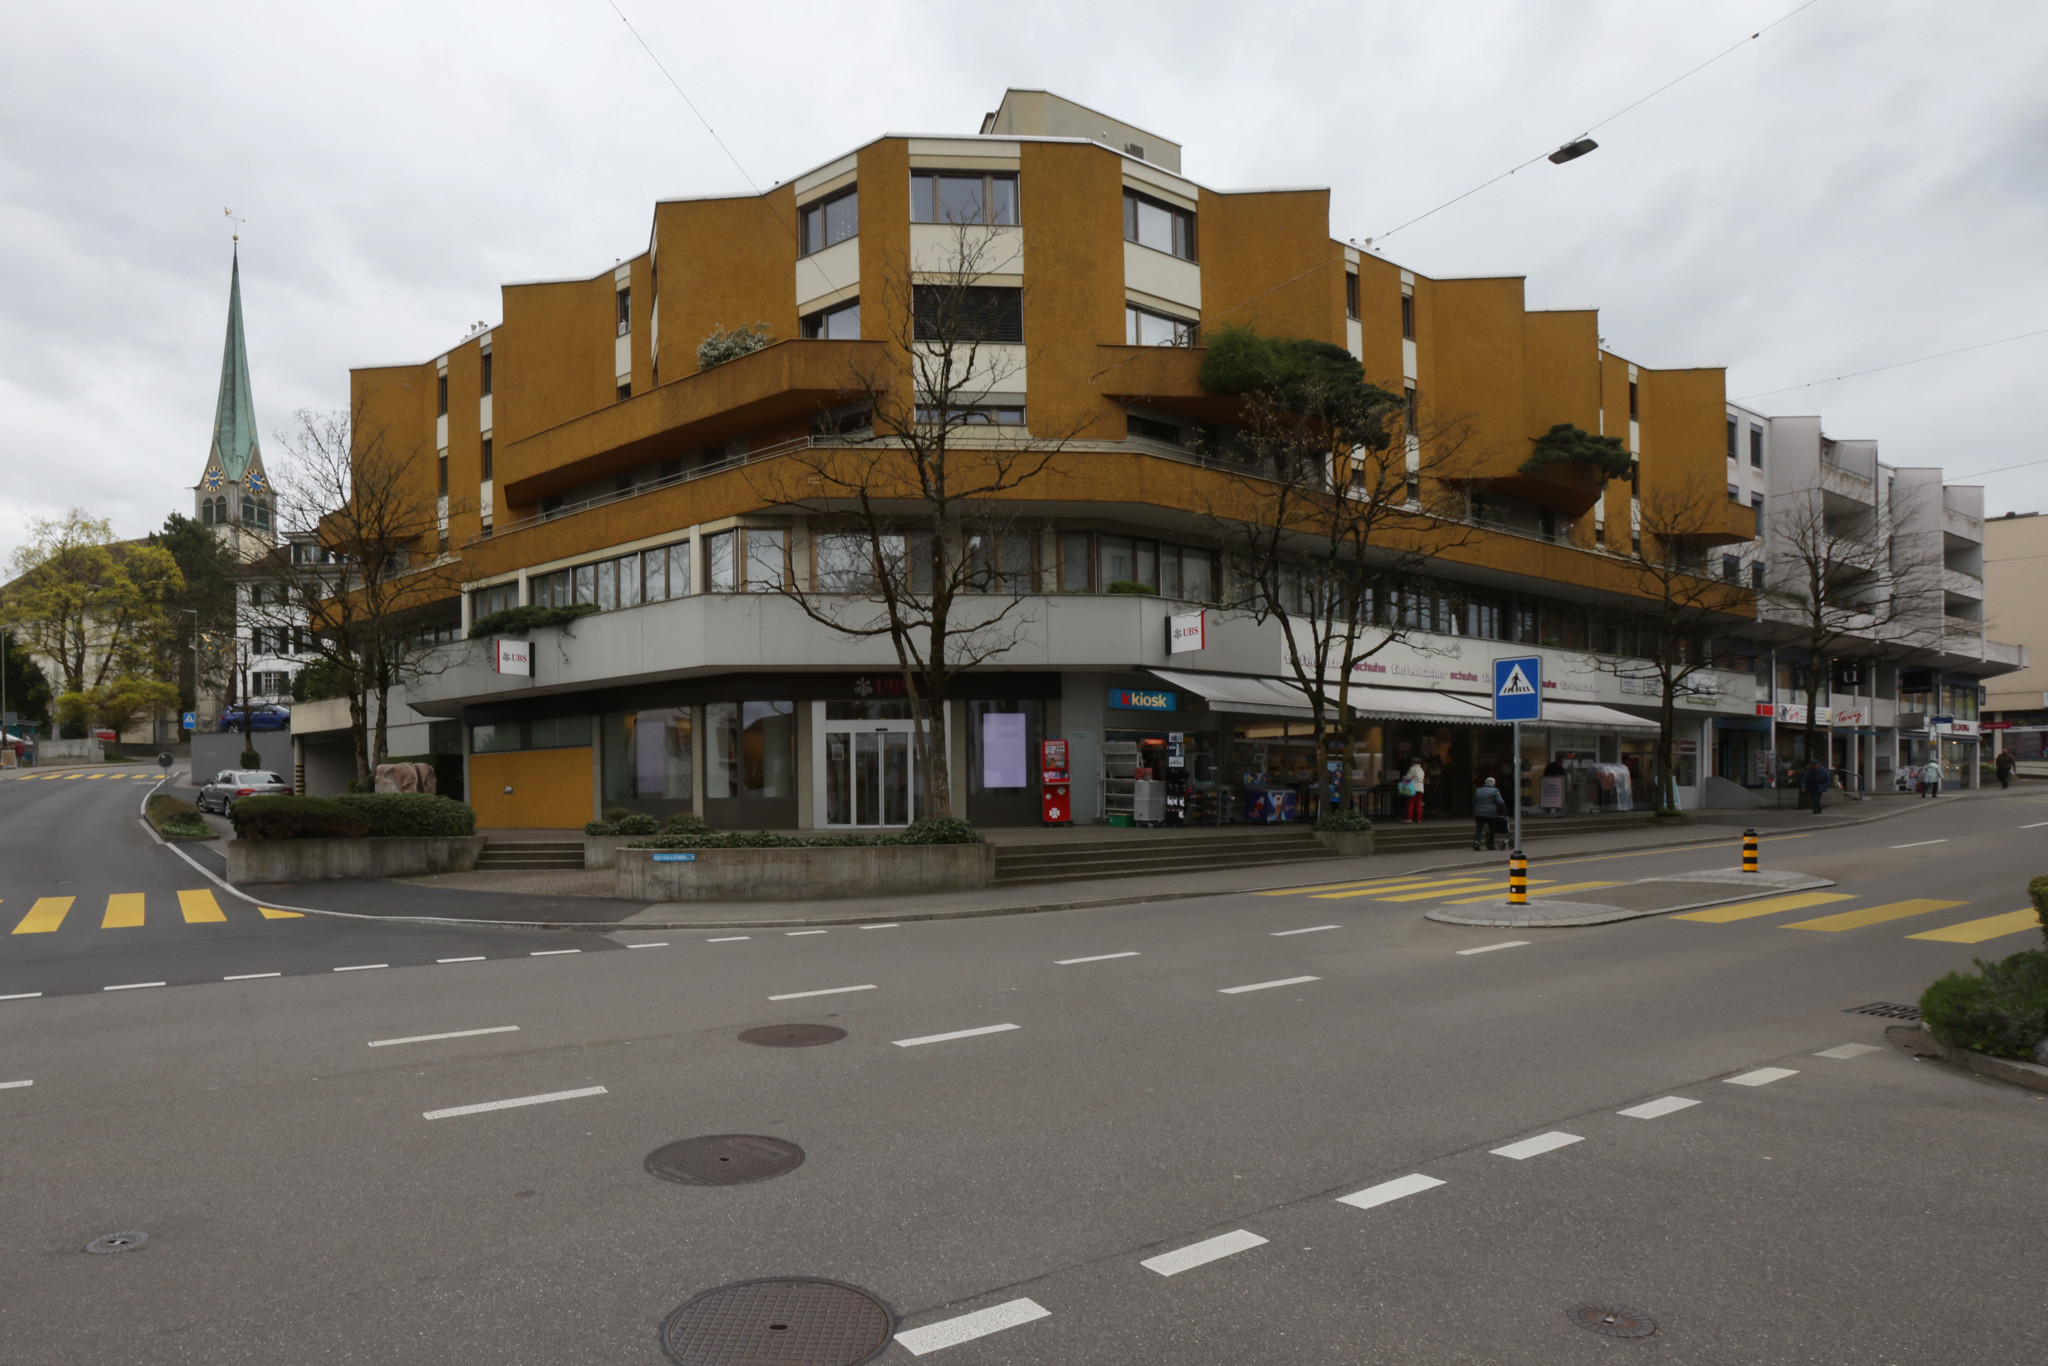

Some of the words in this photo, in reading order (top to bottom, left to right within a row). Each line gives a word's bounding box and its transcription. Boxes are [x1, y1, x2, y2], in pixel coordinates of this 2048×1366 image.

[1183, 626, 1199, 637] UBS
[511, 653, 527, 663] UBS
[1450, 671, 1478, 682] schuhe
[1131, 692, 1167, 708] kiosk
[1835, 709, 1862, 724] Tevy
